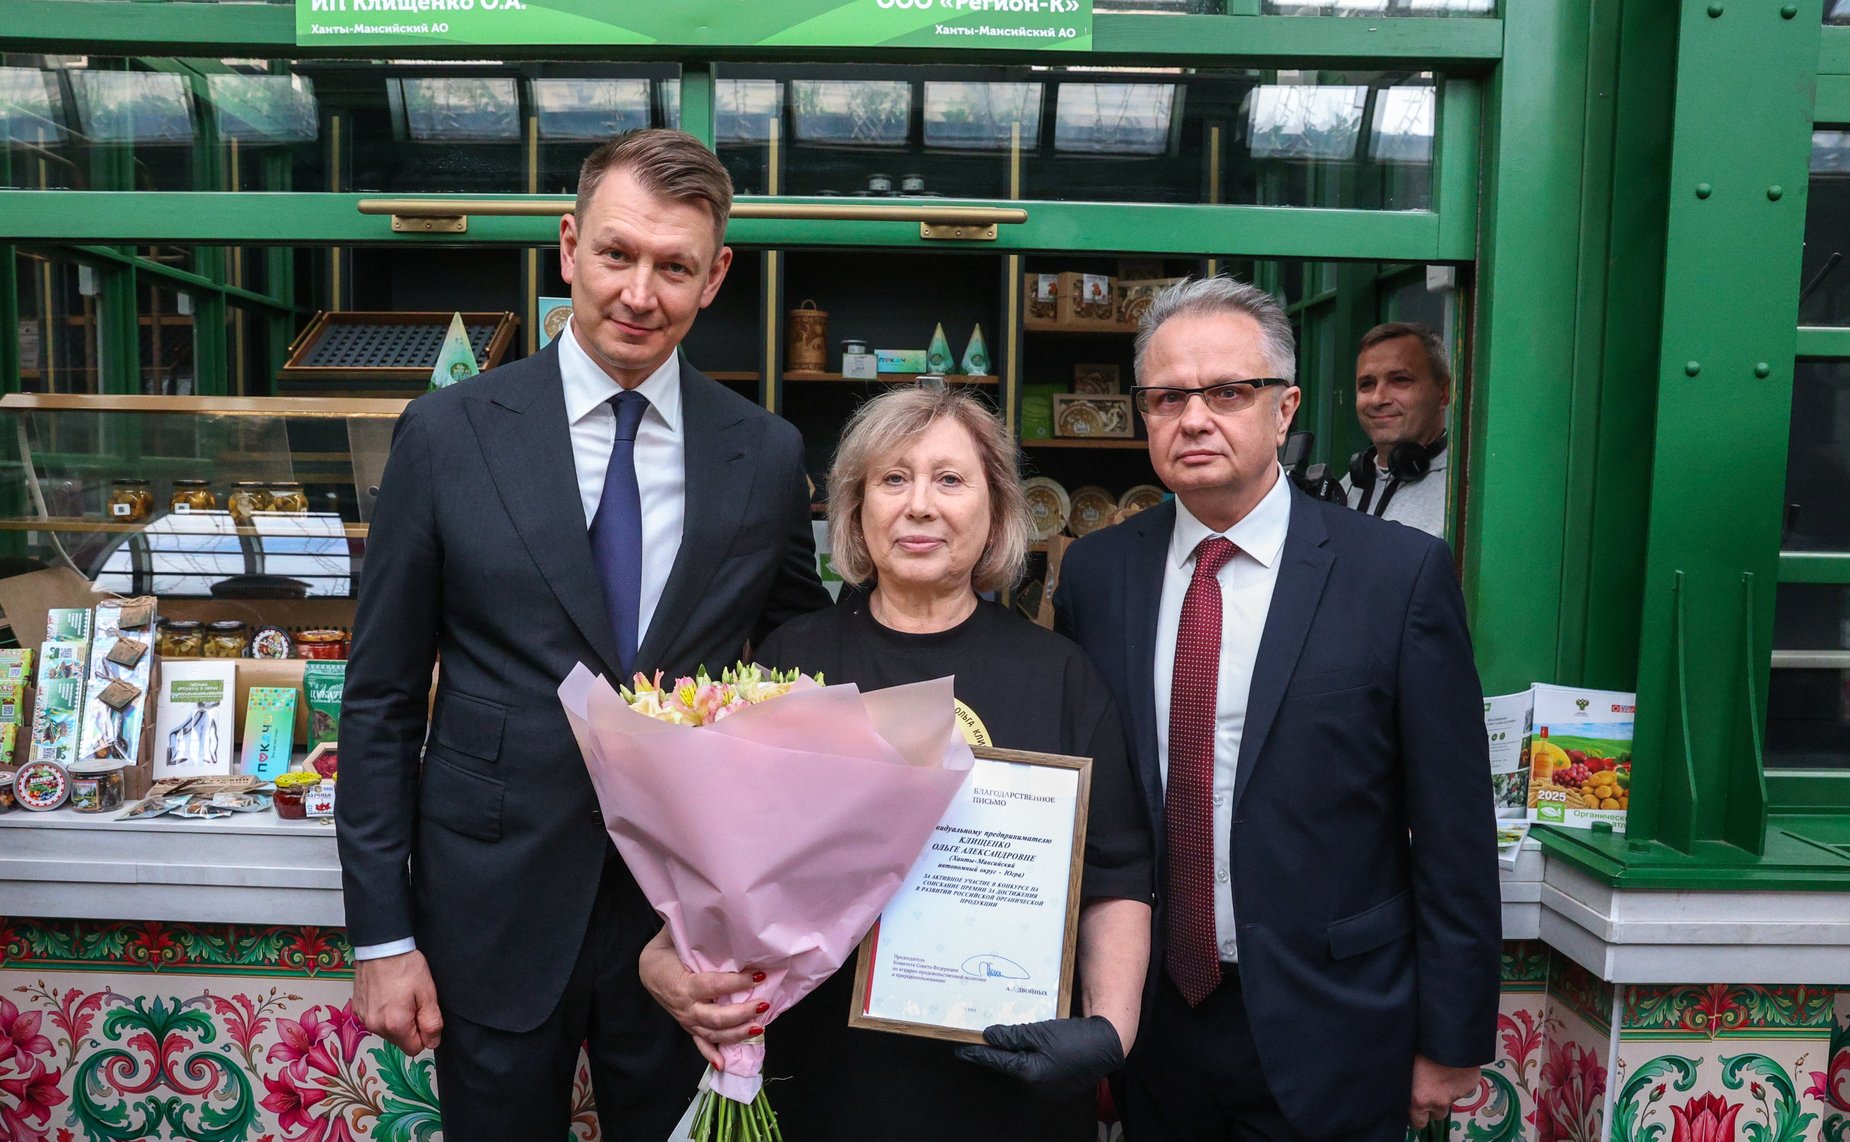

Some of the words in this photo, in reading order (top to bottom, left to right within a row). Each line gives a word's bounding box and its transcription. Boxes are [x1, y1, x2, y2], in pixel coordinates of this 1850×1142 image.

[311, 23, 428, 34] Ханты-Мансийский
[431, 23, 449, 33] АО
[935, 24, 1056, 38] Ханты-Мансийский
[1058, 28, 1076, 38] АО
[1320, 480, 1329, 497] SONY
[954, 707, 975, 728] ОЛЬГА
[972, 797, 1007, 807] ПИСЬМО
[973, 787, 1056, 804] БЛАГОДАРСТВЕННОЕ
[1538, 790, 1566, 802] 2025
[1573, 810, 1627, 822] Органическ
[935, 824, 983, 837] видуальному
[983, 831, 1053, 845] предпринимателю
[958, 836, 1011, 849] КЛИЩЕНКО
[931, 843, 959, 854] ОЛЬГЕ
[961, 846, 1037, 863] АЛЕКСАНДРОВНЕ
[948, 854, 1016, 869] (Ханты-Мансийский
[937, 862, 979, 873] автономный
[979, 868, 997, 876] округ
[1003, 870, 1025, 879] Югра)
[922, 880, 959, 890] СОИСКАНИЕ
[996, 889, 1039, 899] ДОСТИЖЕНИЯ
[931, 874, 963, 884] АКТИВНОЕ
[964, 877, 991, 887] УЧАСТИЕ
[997, 882, 1029, 892] КОНКУРСЕ
[953, 890, 995, 901] РОССИЙСКОЙ
[996, 895, 1045, 907] ОРГАНИЧЕСКОЙ
[1017, 987, 1048, 996] ДВОЙНЫХ
